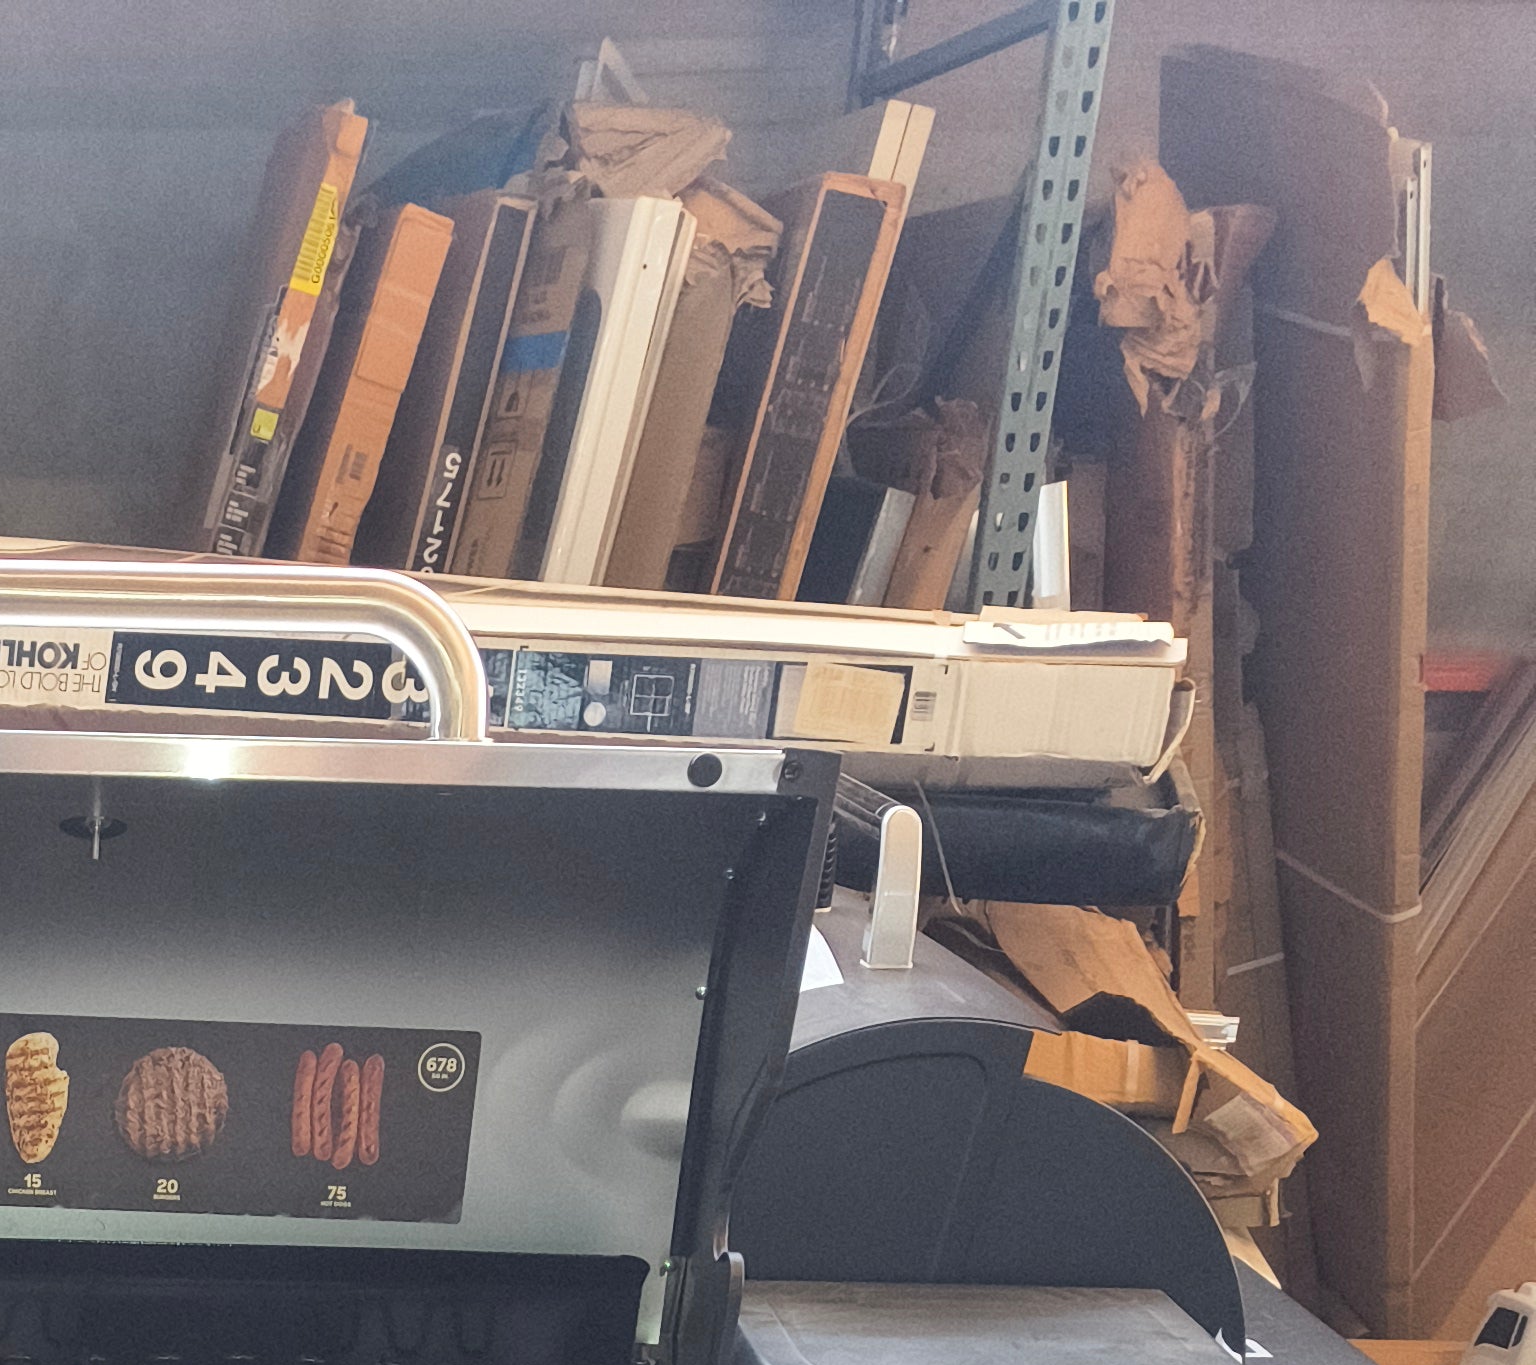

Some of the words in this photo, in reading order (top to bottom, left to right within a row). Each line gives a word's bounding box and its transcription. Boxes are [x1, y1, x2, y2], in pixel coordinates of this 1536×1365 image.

[82, 651, 107, 671] OF
[19, 672, 68, 692] BOLD
[72, 673, 102, 693] THE
[134, 649, 430, 704] 32349
[426, 1057, 457, 1073] 678
[24, 1173, 42, 1188] 15
[156, 1179, 179, 1194] 20
[327, 1185, 347, 1200] 75
